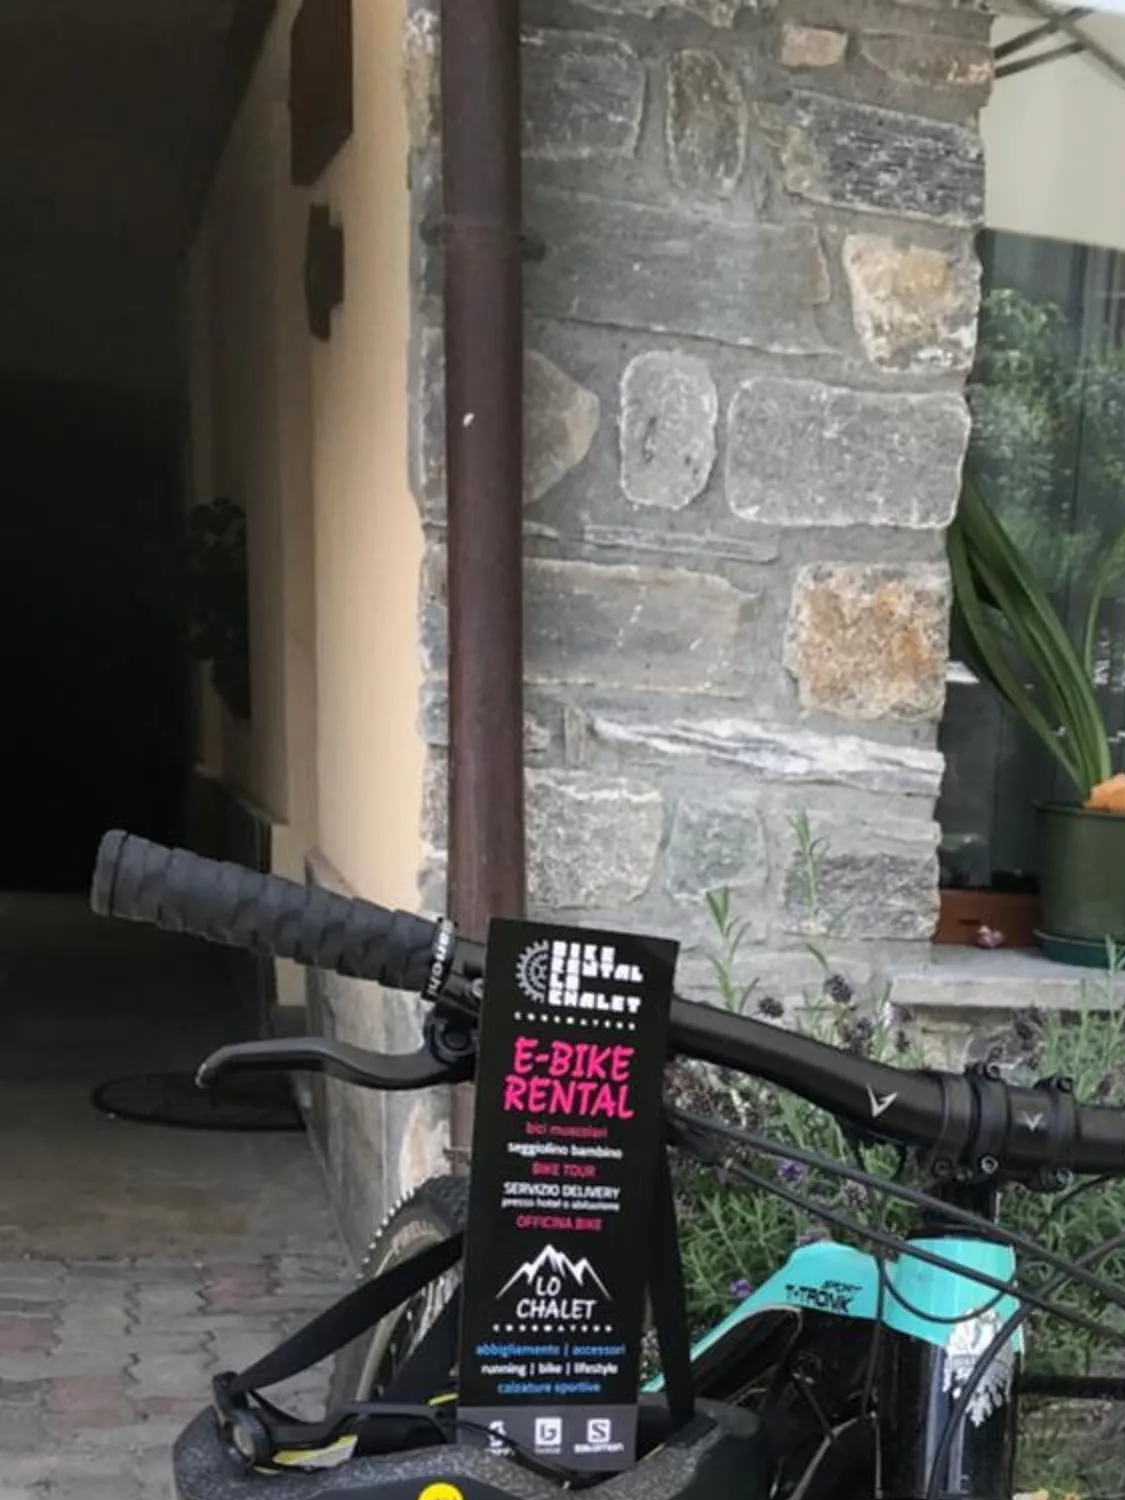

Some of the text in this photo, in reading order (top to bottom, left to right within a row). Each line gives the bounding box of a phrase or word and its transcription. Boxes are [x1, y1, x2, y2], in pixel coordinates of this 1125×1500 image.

[547, 988, 641, 1014] CHALET
[514, 1036, 635, 1082] E-BIKE
[503, 1074, 635, 1119] RENTAL
[562, 1163, 597, 1178] TOUR
[503, 1181, 620, 1200] SERVIZIO DELIVERY
[516, 1215, 573, 1229] OFFICINA
[536, 1275, 562, 1297] LO
[515, 1298, 598, 1320] CHALET
[480, 1362, 527, 1377] running
[538, 1362, 563, 1375] bike
[573, 1362, 619, 1376] lifestyle
